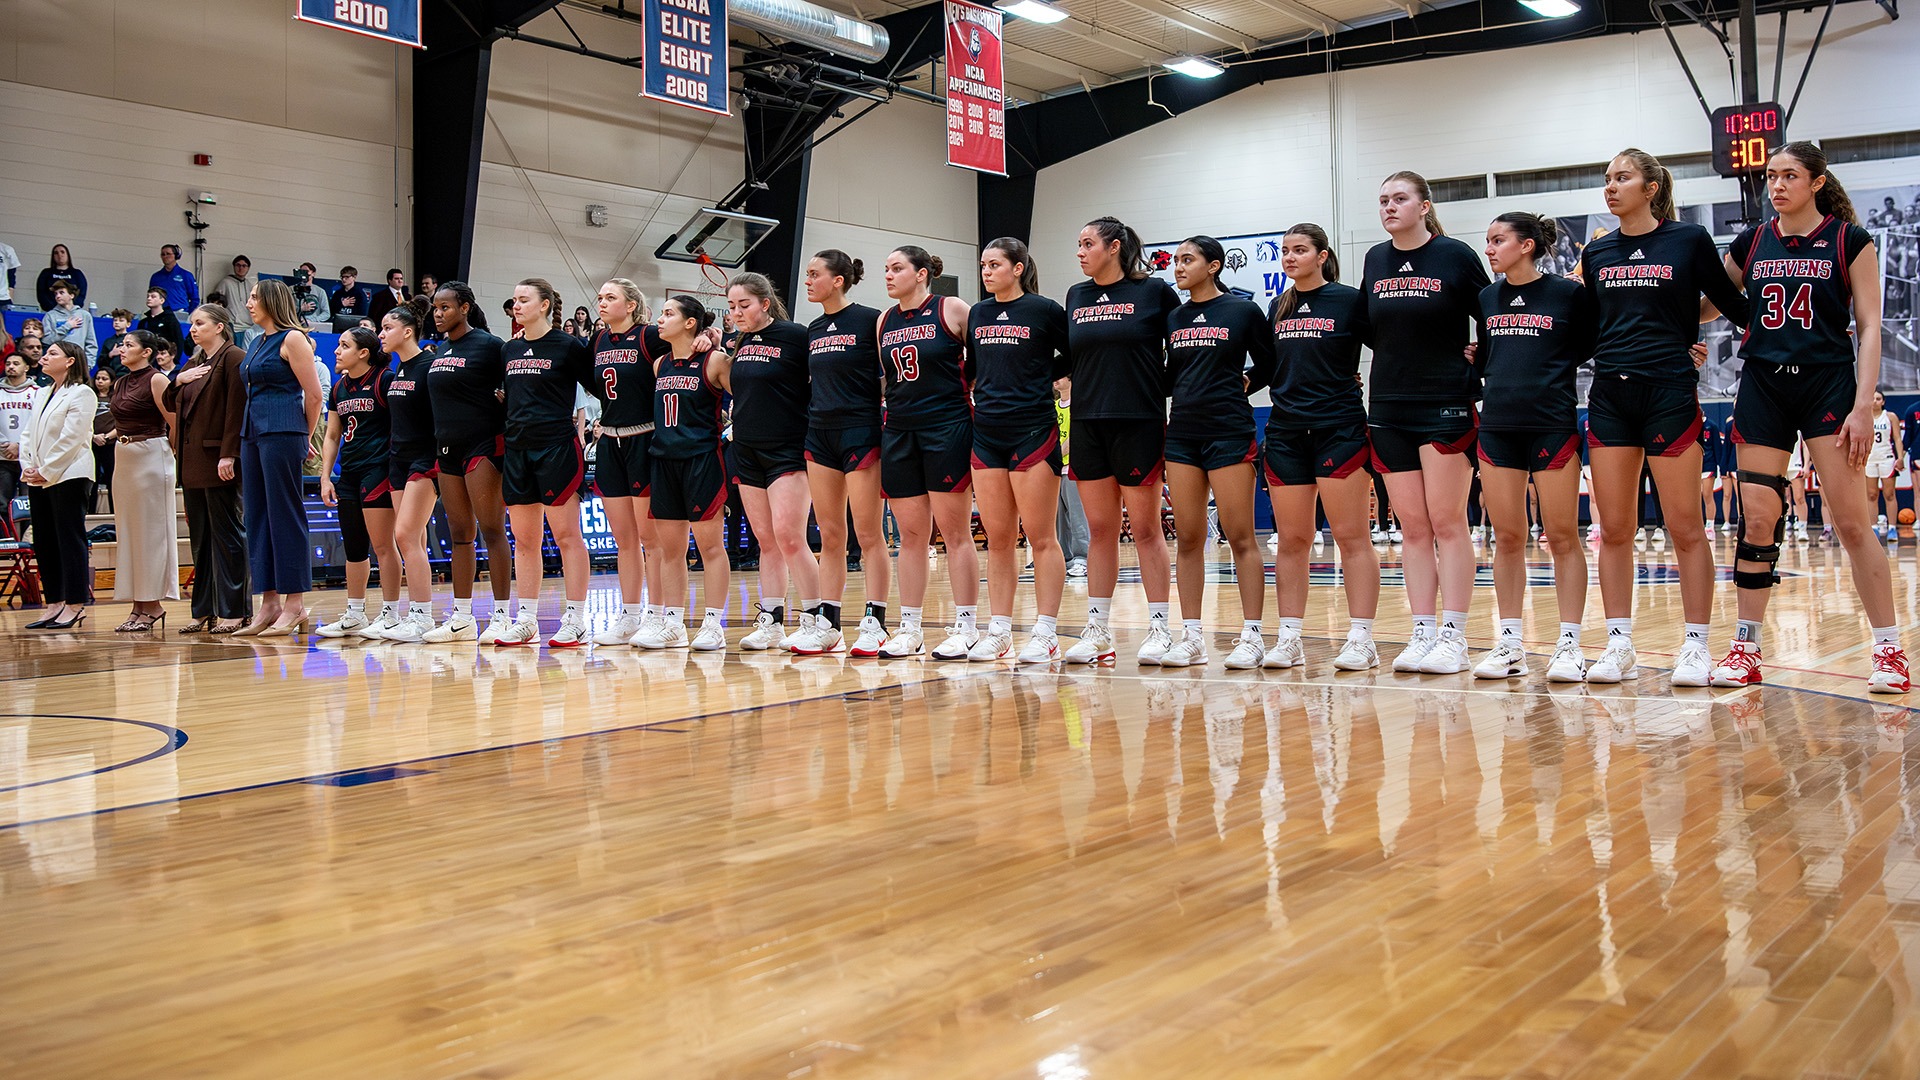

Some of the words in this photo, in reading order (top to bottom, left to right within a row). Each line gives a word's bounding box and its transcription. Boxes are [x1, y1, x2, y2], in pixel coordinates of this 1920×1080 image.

[334, 0, 388, 31] 2010
[661, 11, 711, 46] ELITE
[660, 40, 713, 76] EIGHT
[965, 63, 985, 82] NCAA
[665, 74, 708, 103] 2009
[949, 76, 1002, 103] APPEARANCES
[1725, 110, 1777, 134] 10:00
[1731, 137, 1766, 169] 30
[1598, 264, 1673, 281] STEVENS
[1752, 258, 1833, 280] STEVENS
[1373, 277, 1442, 294] STEVENS
[1605, 279, 1659, 288] BASKETBALL
[1379, 290, 1429, 299] BASKETBALL
[1072, 303, 1135, 320] STEVENS
[1761, 282, 1813, 330] 34
[1076, 314, 1122, 324] BASKETBALL
[1274, 318, 1335, 334] STEVENS
[1486, 313, 1553, 330] STEVENS
[881, 323, 936, 348] STEVENS
[975, 325, 1031, 339] STEVENS
[1169, 327, 1230, 344] STEVENS
[1278, 331, 1323, 340] BASKETBALL
[1490, 328, 1540, 337] BASKETBALL
[808, 334, 857, 351] STEVENS
[980, 337, 1020, 345] BASKETBALL
[1172, 339, 1217, 349] BASKETBALL
[595, 349, 639, 367] STEVENS
[811, 345, 846, 355] BASKETBALL
[890, 344, 920, 383] 13
[602, 367, 617, 400] 2
[655, 375, 700, 392] STEVENS
[0, 402, 33, 410] TEVENS
[663, 393, 679, 428] 11
[9, 415, 20, 430] 3
[344, 415, 358, 443] 3
[1875, 431, 1883, 444] 3
